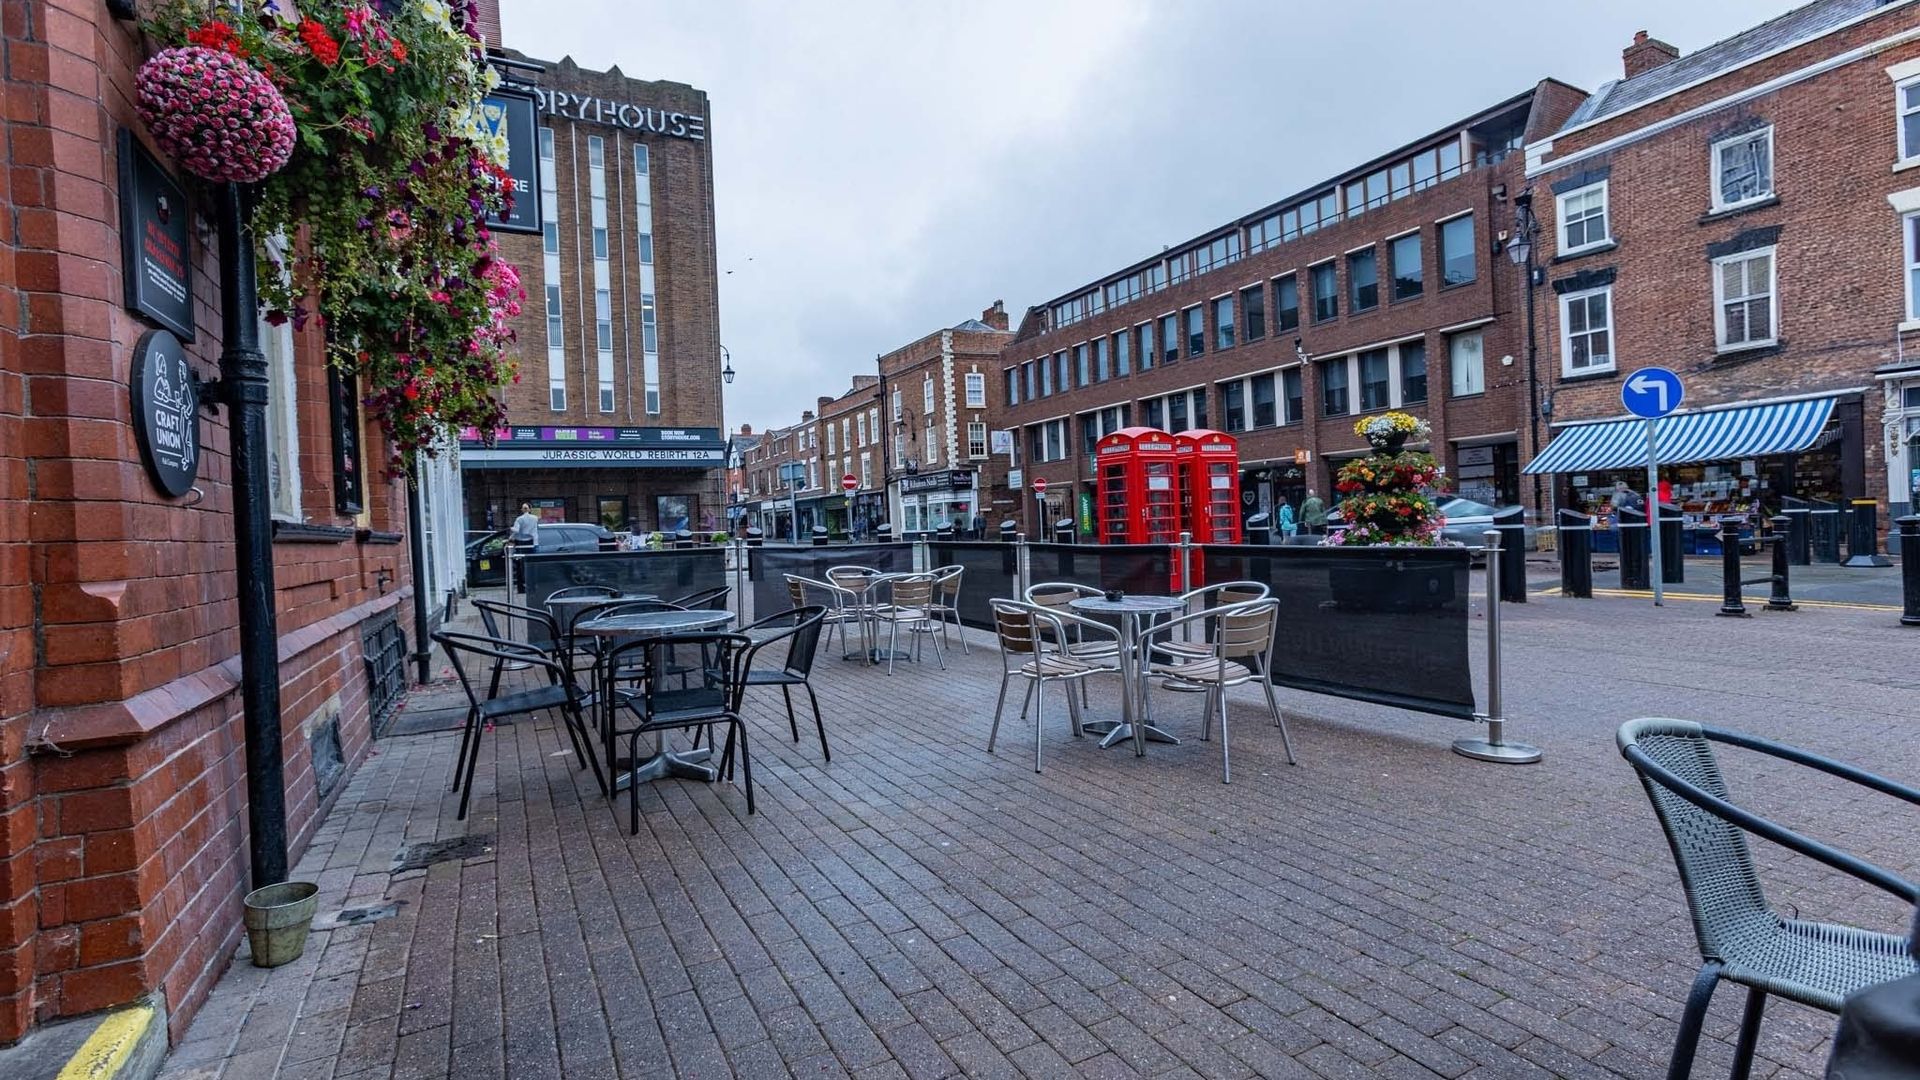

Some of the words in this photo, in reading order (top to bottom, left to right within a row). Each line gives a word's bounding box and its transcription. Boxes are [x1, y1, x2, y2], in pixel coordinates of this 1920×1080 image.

[519, 83, 704, 140] ORYHOUSE
[155, 409, 180, 432] CRAFT
[156, 427, 181, 449] UNION
[542, 450, 597, 460] JURASSIC
[602, 450, 642, 459] WORLD
[648, 450, 688, 459] REBIRTH
[693, 450, 710, 459] 12A
